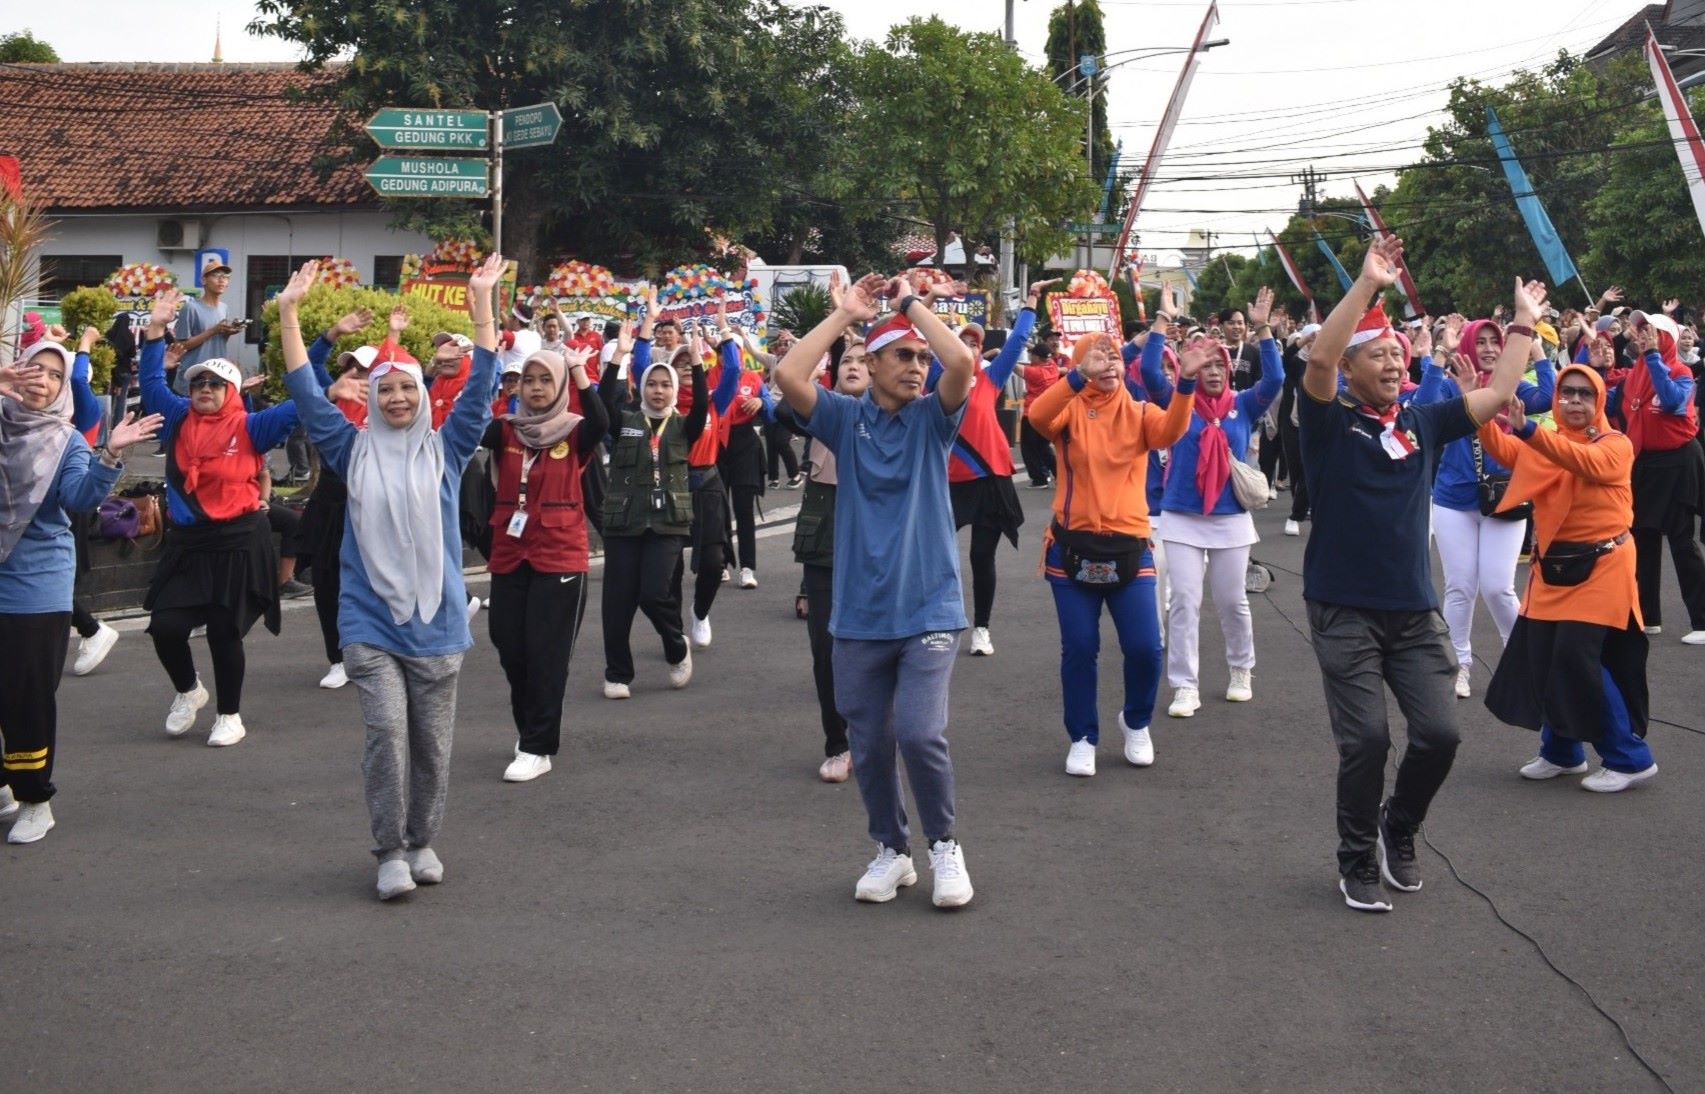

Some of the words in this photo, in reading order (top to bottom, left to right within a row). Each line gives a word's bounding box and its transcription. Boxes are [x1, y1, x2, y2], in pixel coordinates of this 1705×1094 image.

[403, 113, 465, 127] SANTEL
[394, 131, 446, 143] GEDUNG
[449, 132, 473, 144] PKK
[401, 161, 459, 174] MUSHOLA
[380, 178, 428, 191] GEDUNG
[430, 180, 479, 192] ADIPURA
[410, 283, 443, 303] HUT
[443, 286, 467, 305] KE
